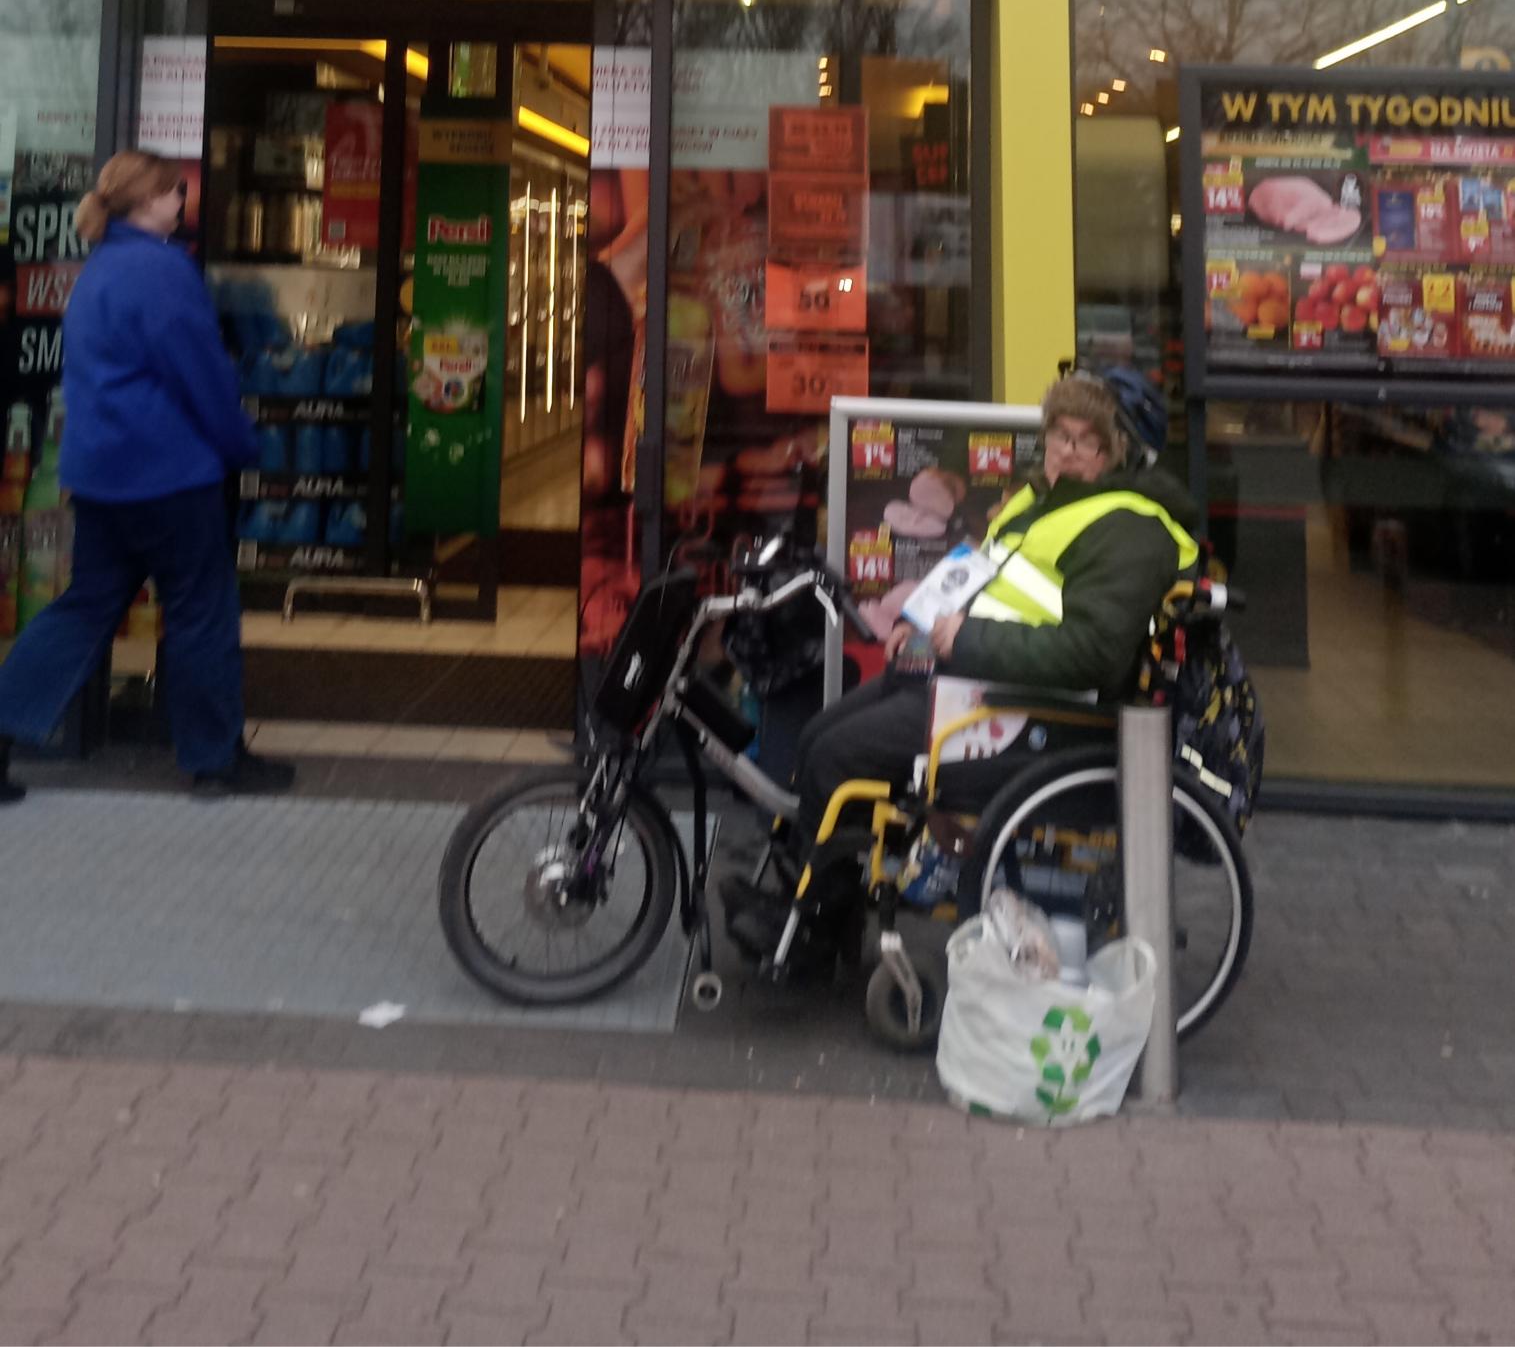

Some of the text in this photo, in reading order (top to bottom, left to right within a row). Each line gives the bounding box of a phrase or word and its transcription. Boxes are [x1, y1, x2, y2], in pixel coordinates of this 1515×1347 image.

[1221, 91, 1258, 123] W
[1266, 92, 1337, 126] TYM
[14, 204, 90, 260] SPR
[27, 270, 69, 310] WS
[18, 325, 65, 373] SM
